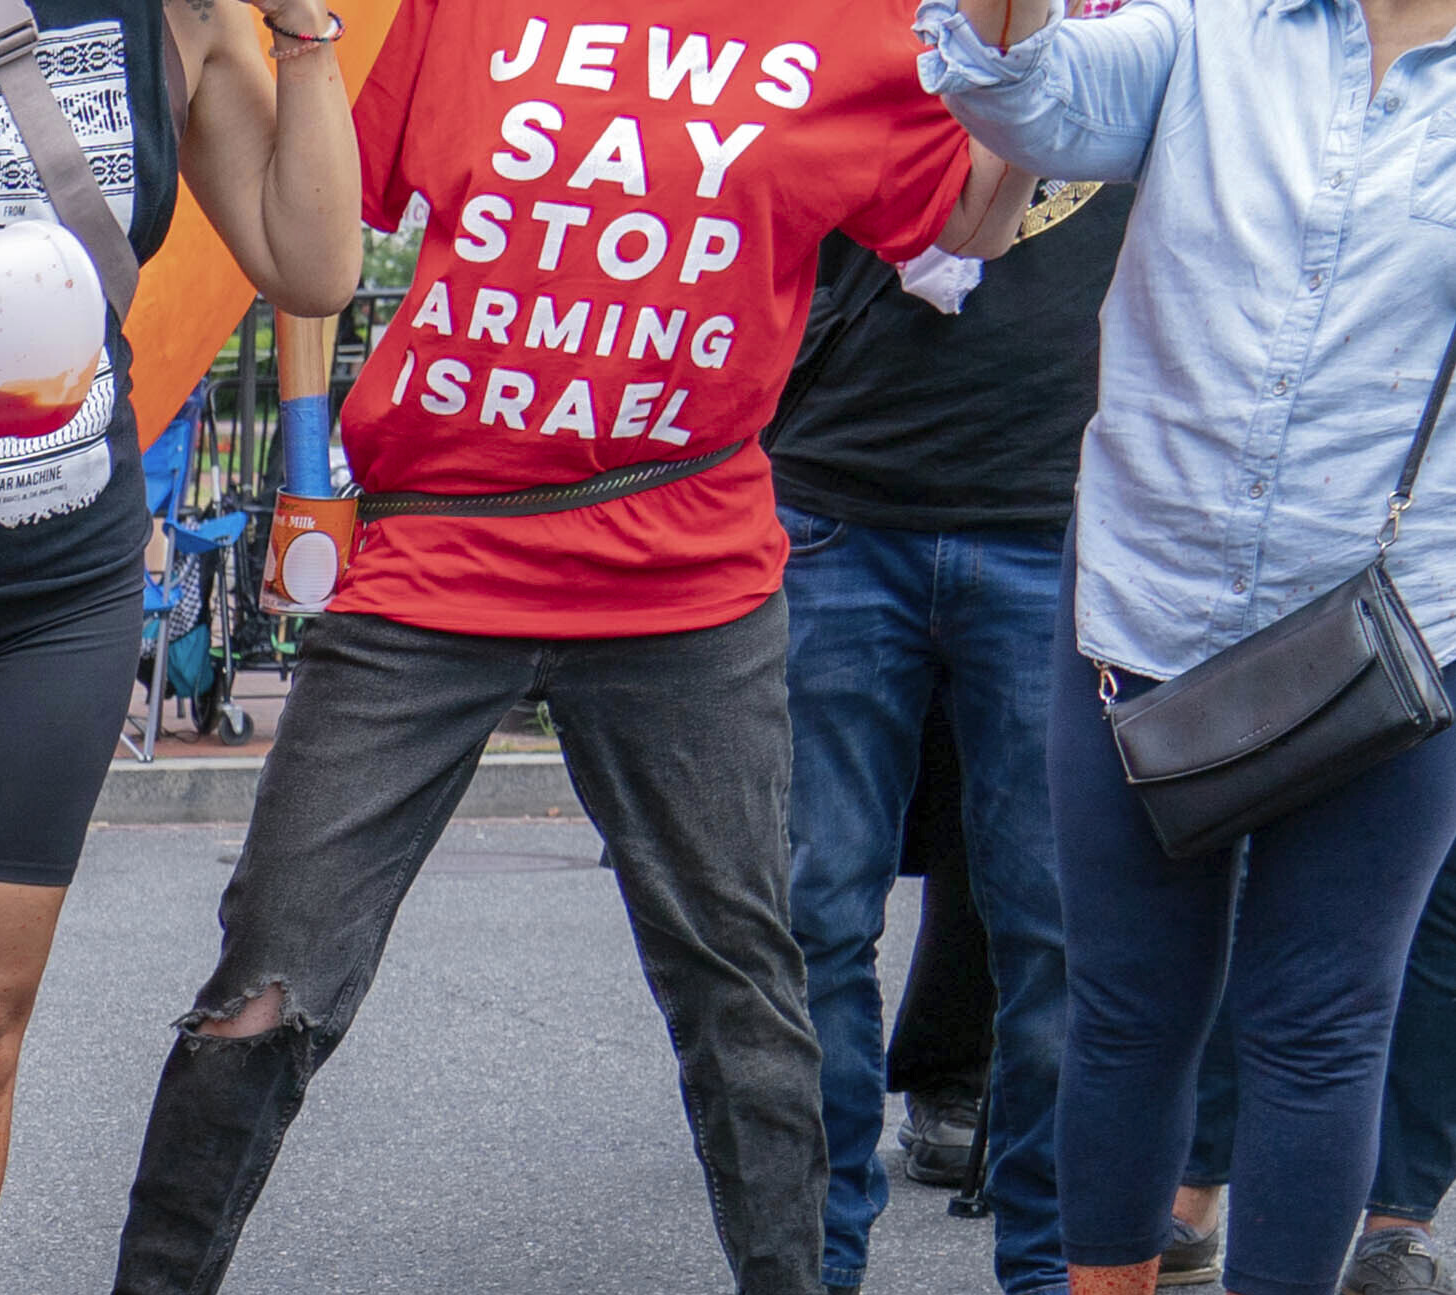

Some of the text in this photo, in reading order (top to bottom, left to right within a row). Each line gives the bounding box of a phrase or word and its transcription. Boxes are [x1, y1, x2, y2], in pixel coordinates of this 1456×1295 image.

[489, 17, 820, 110] JEWS
[491, 100, 766, 199] SAY
[3, 205, 26, 217] FROM
[453, 194, 742, 284] STOP
[411, 280, 735, 369] ARMING
[390, 349, 693, 447] ISRAEL
[16, 464, 63, 489] MACHINE
